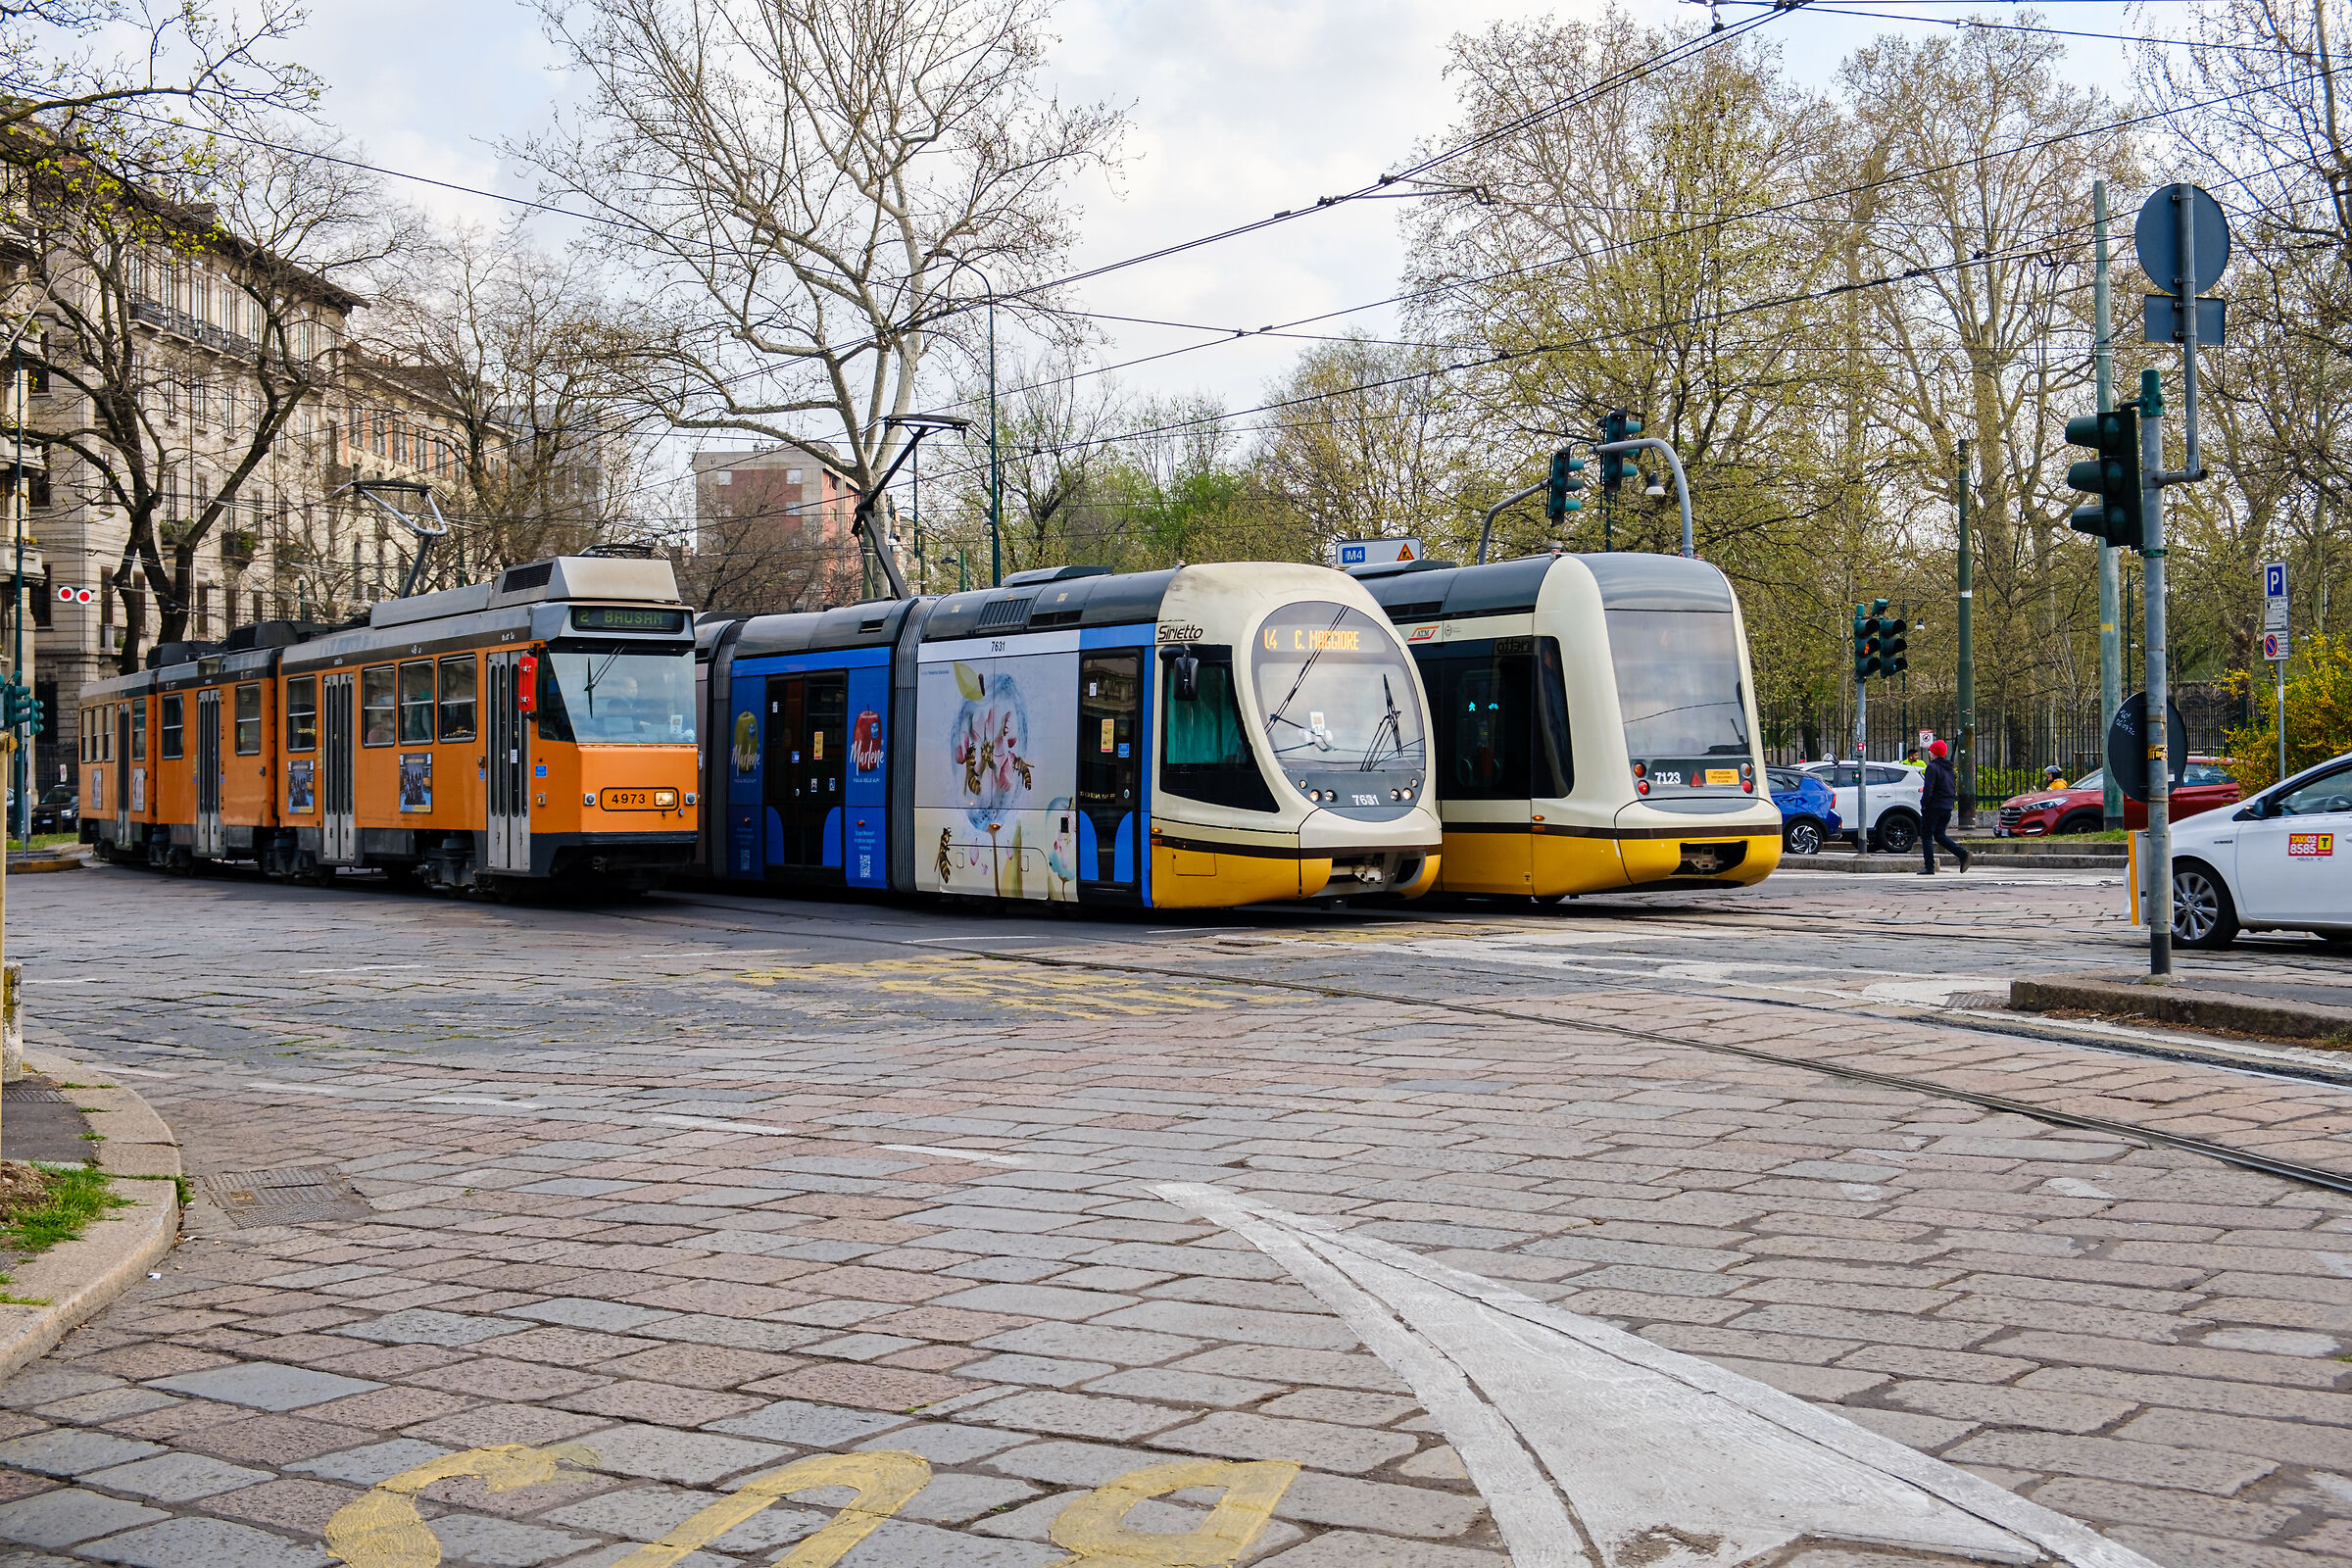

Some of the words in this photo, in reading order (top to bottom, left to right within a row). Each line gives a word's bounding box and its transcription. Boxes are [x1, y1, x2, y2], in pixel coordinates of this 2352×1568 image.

[1347, 550, 1363, 561] M4
[2271, 571, 2280, 592] P
[579, 611, 589, 622] 2
[605, 611, 663, 624] BAUSAN
[1295, 630, 1305, 650] C.
[1308, 630, 1359, 651] MAGGIORE
[991, 641, 1005, 653] 7631
[731, 744, 760, 777] Marlene
[850, 740, 885, 777] Marlene
[1654, 772, 1682, 785] 7123
[612, 794, 646, 804] 4973
[1351, 795, 1380, 806] 7631
[2322, 837, 2329, 848] T
[2289, 843, 2317, 855] 8585
